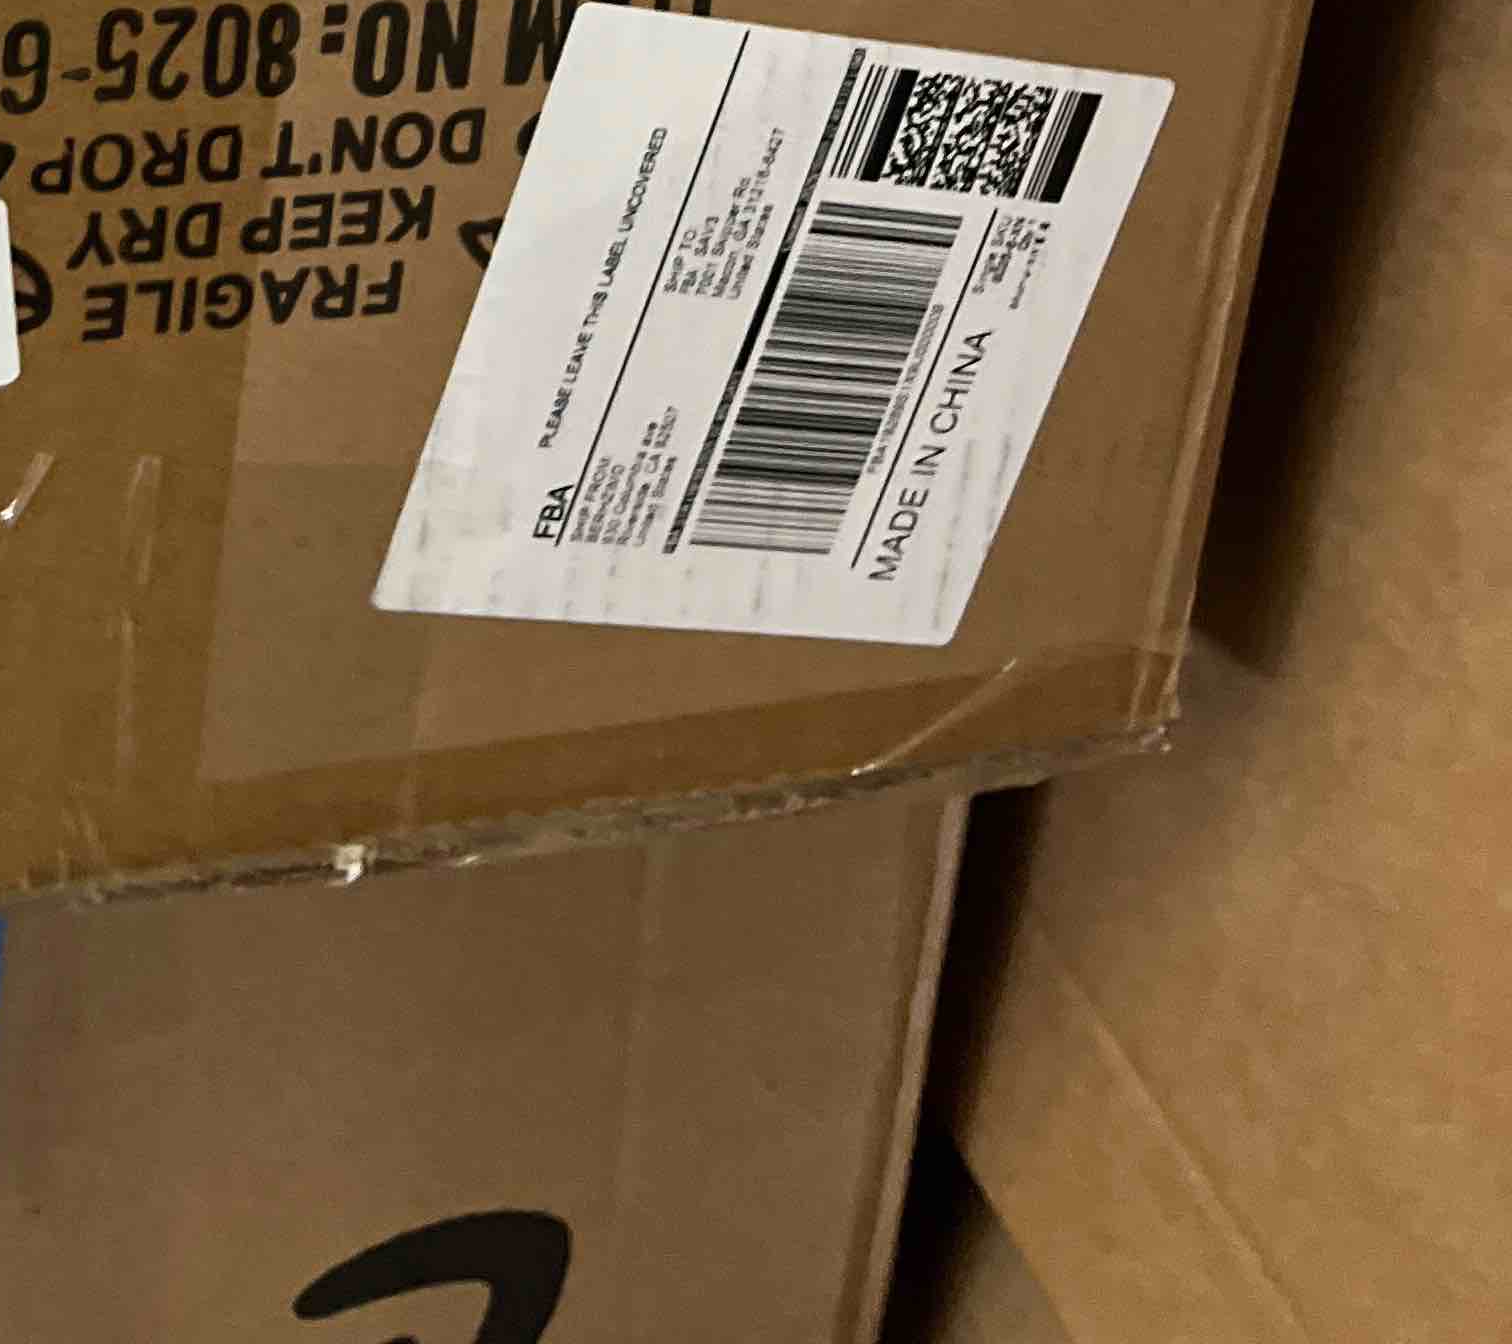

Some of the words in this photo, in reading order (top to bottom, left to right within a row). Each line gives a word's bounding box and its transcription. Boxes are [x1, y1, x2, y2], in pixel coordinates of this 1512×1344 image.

[31, 126, 244, 195] DROP
[271, 107, 487, 178] DON'T
[69, 200, 222, 269] DRY
[242, 185, 436, 256] KEEP
[82, 261, 405, 341] FRAGILE
[537, 385, 575, 448] PLEASE
[561, 331, 594, 383] LEAVE
[582, 290, 610, 327] THIS
[596, 236, 630, 287] LABEL
[617, 125, 670, 232] UNCOVERED
[925, 327, 994, 435] CHINA
[909, 444, 947, 476] IN
[531, 482, 574, 539] FBA
[866, 486, 931, 581] MADE
